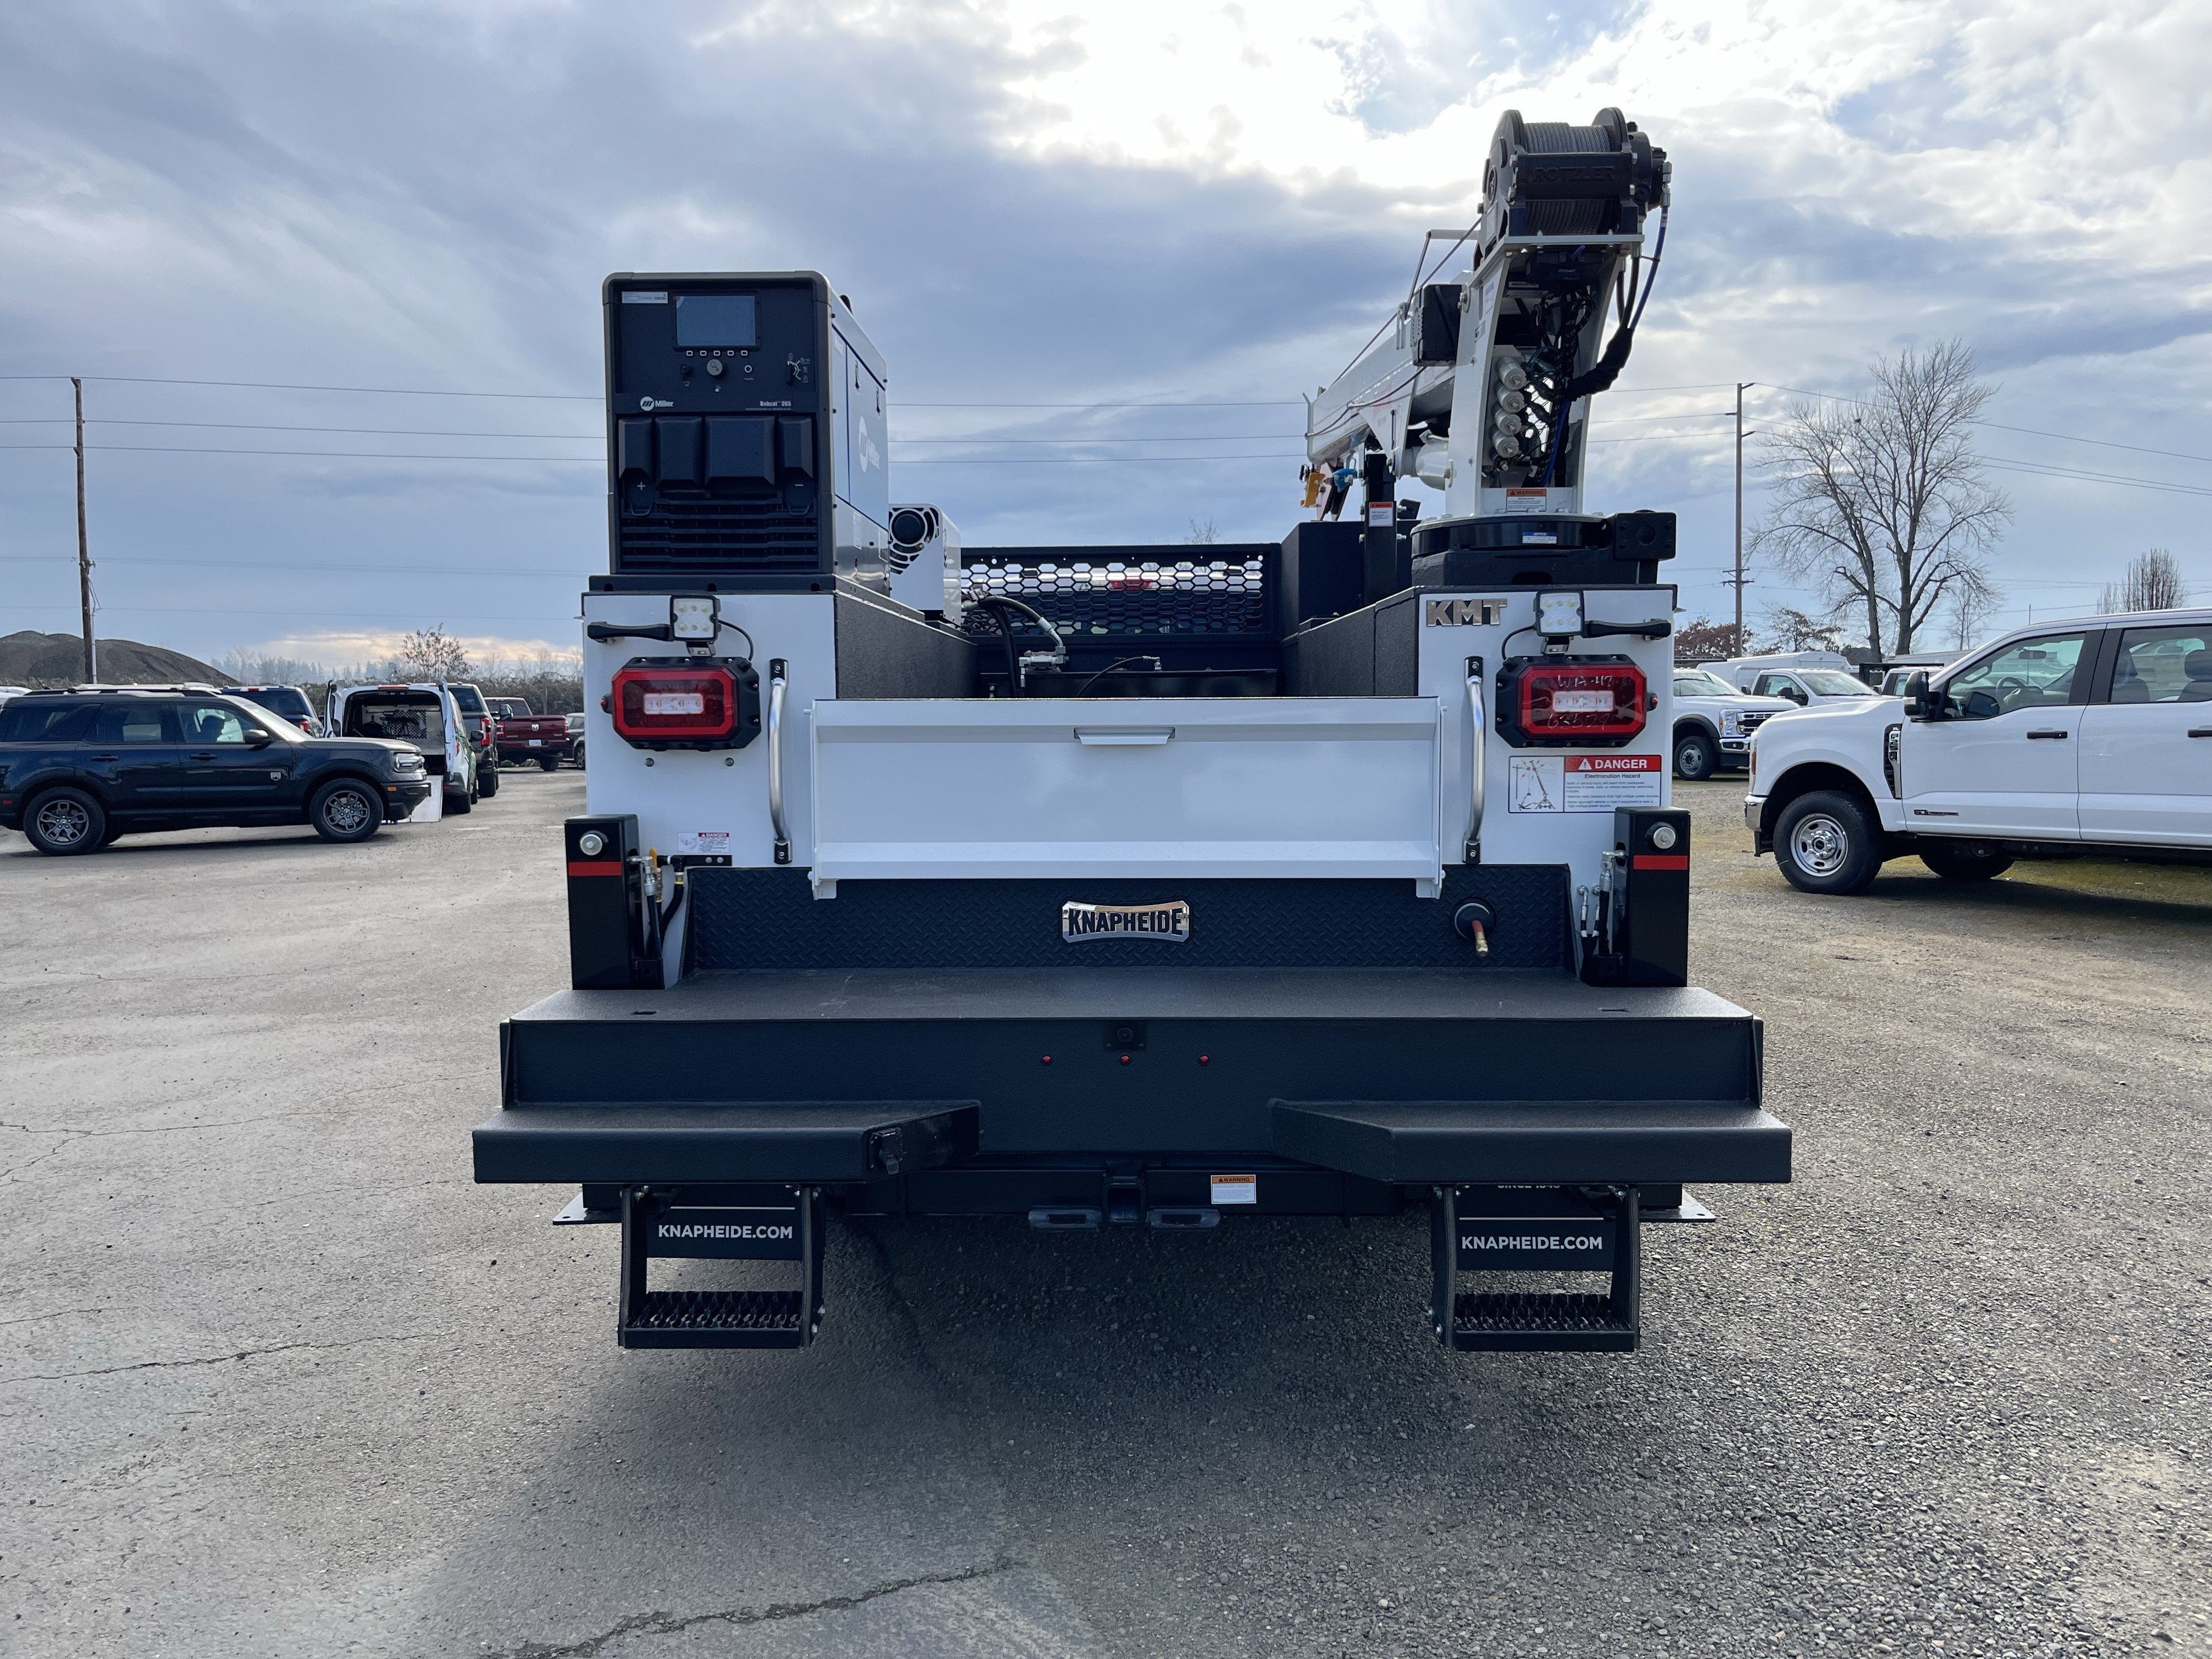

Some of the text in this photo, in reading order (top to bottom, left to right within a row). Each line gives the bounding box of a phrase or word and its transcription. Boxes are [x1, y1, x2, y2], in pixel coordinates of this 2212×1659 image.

[1426, 598, 1507, 627] KMT
[1595, 759, 1647, 769] DANGER
[1069, 907, 1183, 936] KNAPHEIDE
[658, 1225, 793, 1239] KNAPHEIDE.COM
[1462, 1237, 1602, 1250] KNAPHEIDE.COM
